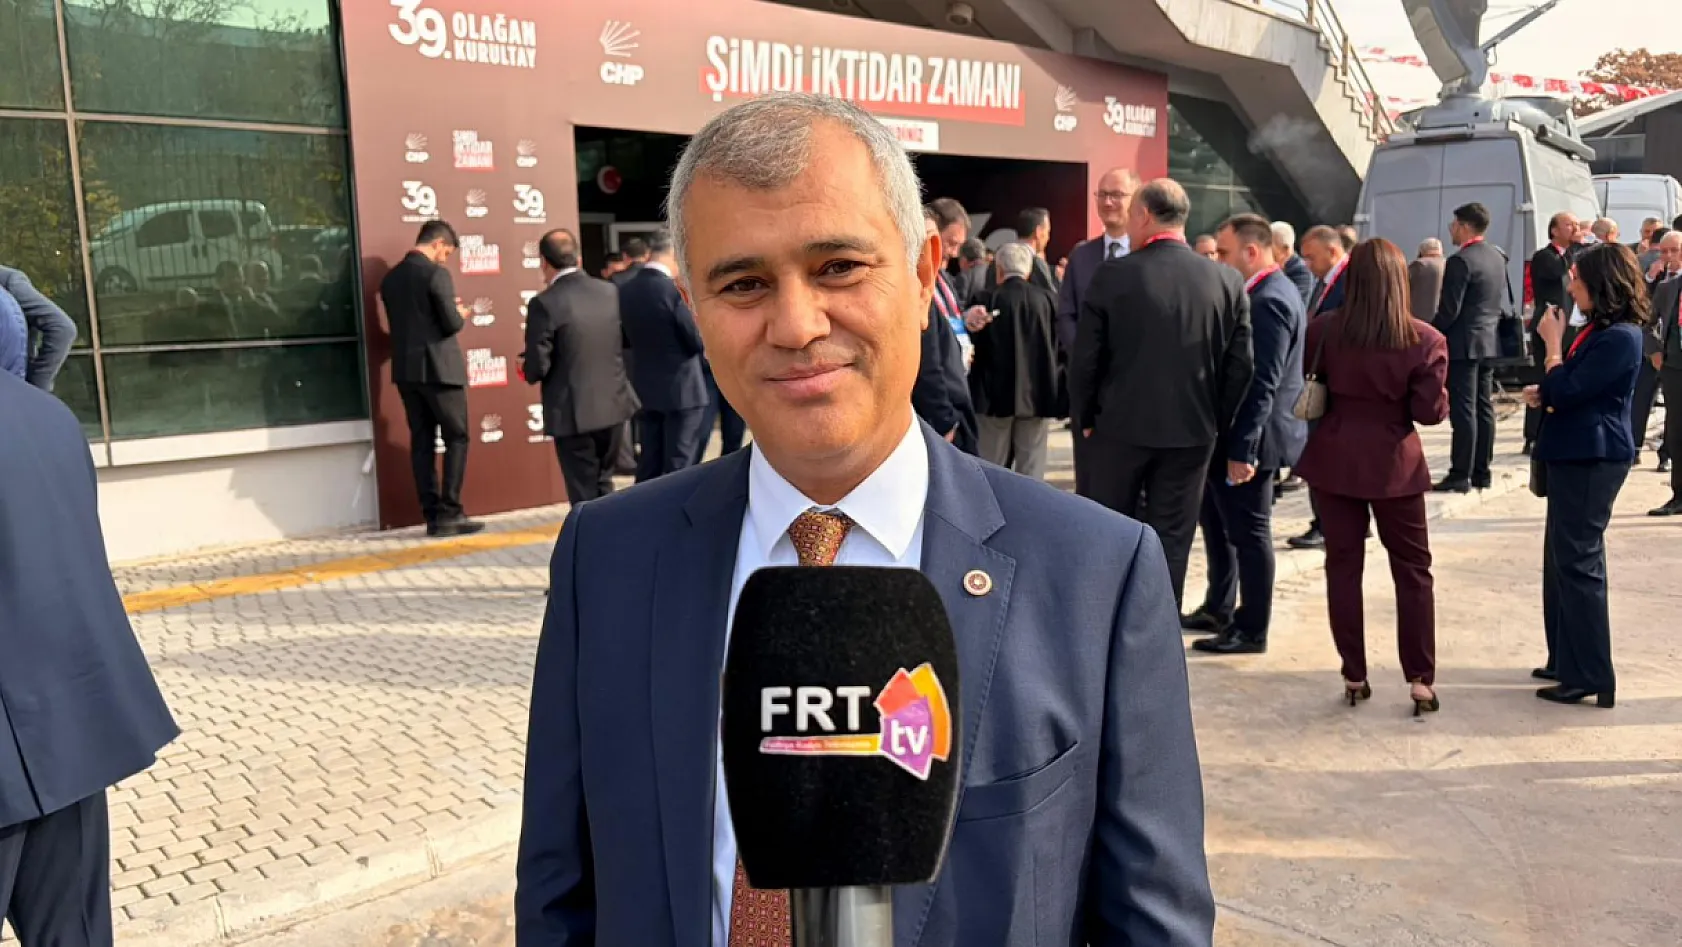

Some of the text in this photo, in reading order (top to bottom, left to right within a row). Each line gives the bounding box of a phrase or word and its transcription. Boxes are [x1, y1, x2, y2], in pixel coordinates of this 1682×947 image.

[452, 12, 536, 47] OLAĞAN
[454, 39, 536, 69] KURULTAY
[600, 61, 644, 85] CHP
[705, 35, 1021, 110] ŞİMDİ İKTİDAR ZAMANI
[761, 686, 928, 755] FRT tv
